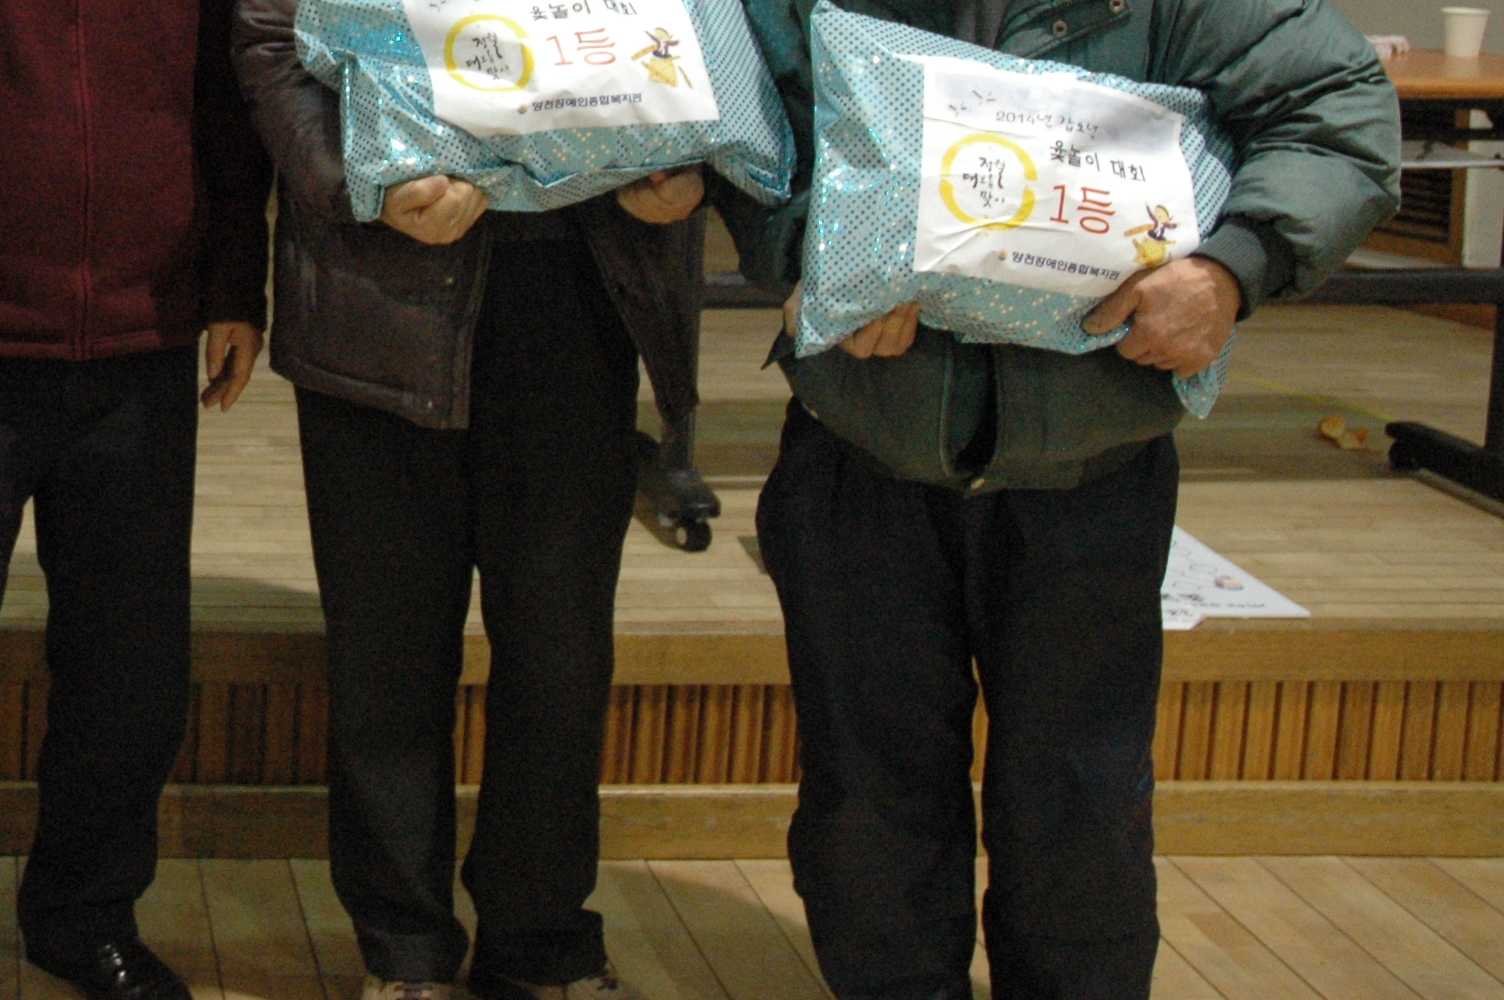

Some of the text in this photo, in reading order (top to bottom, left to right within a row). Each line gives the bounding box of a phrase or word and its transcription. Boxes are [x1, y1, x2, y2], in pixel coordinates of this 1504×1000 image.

[546, 27, 617, 66] 1등
[996, 110, 1053, 129] 2014년
[1050, 140, 1147, 183] 윷놀이 대회
[1049, 184, 1116, 235] 1등
